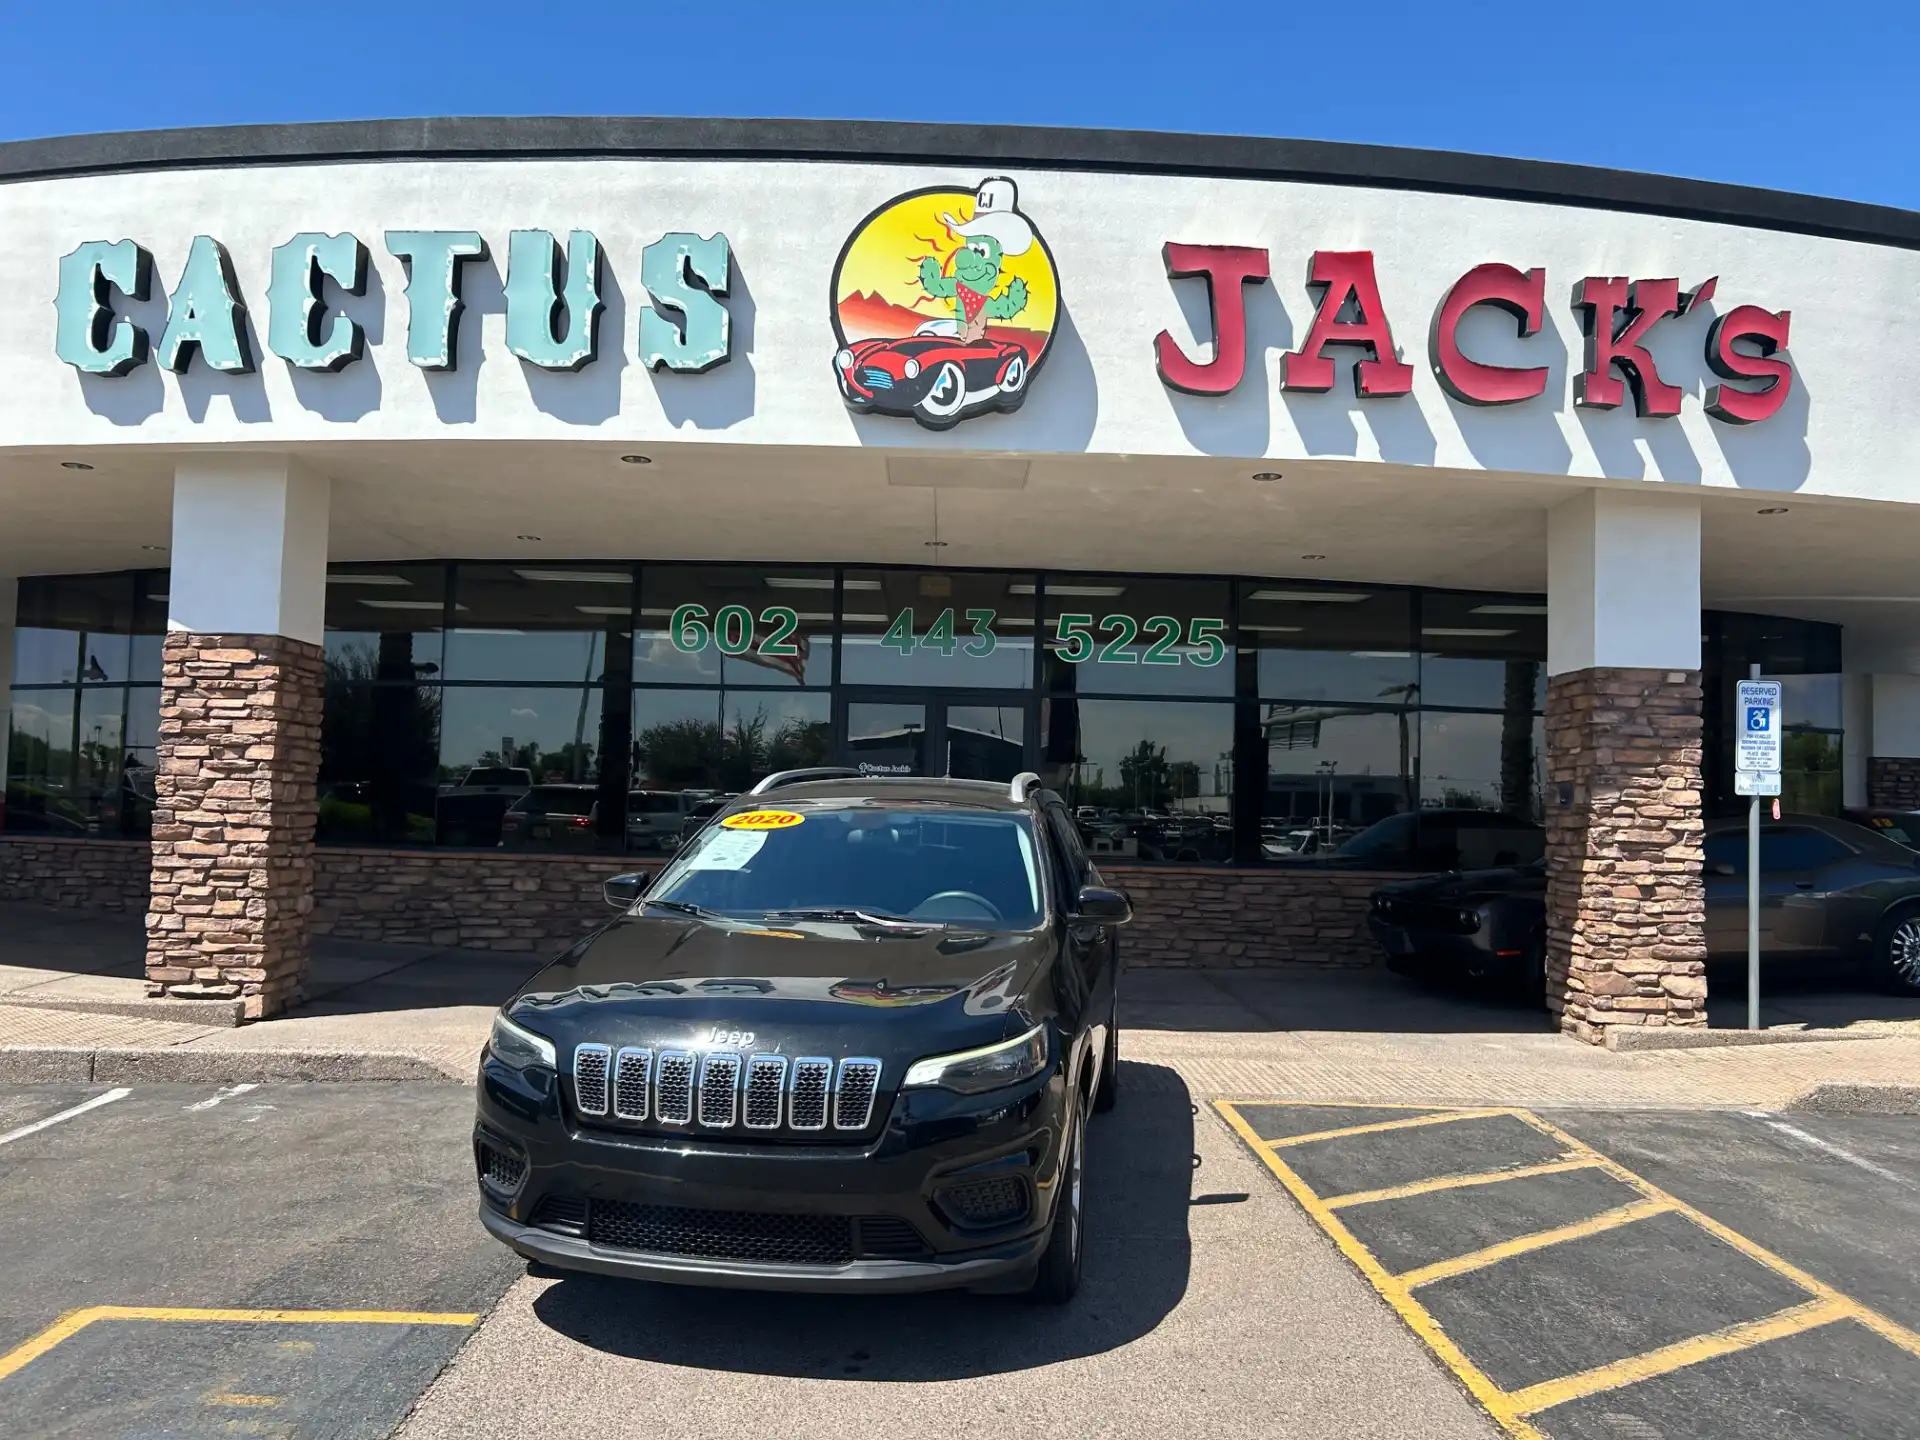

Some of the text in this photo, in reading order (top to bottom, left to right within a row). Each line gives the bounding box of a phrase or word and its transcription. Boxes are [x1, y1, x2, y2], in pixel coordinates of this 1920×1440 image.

[977, 191, 995, 209] CJ
[53, 228, 733, 377] CACTUS
[668, 603, 1226, 667] 602 443 5225
[1741, 687, 1777, 696] RESERVED
[1744, 697, 1774, 706] PARKING
[731, 814, 797, 825] 2020
[709, 1026, 756, 1048] Jeep
